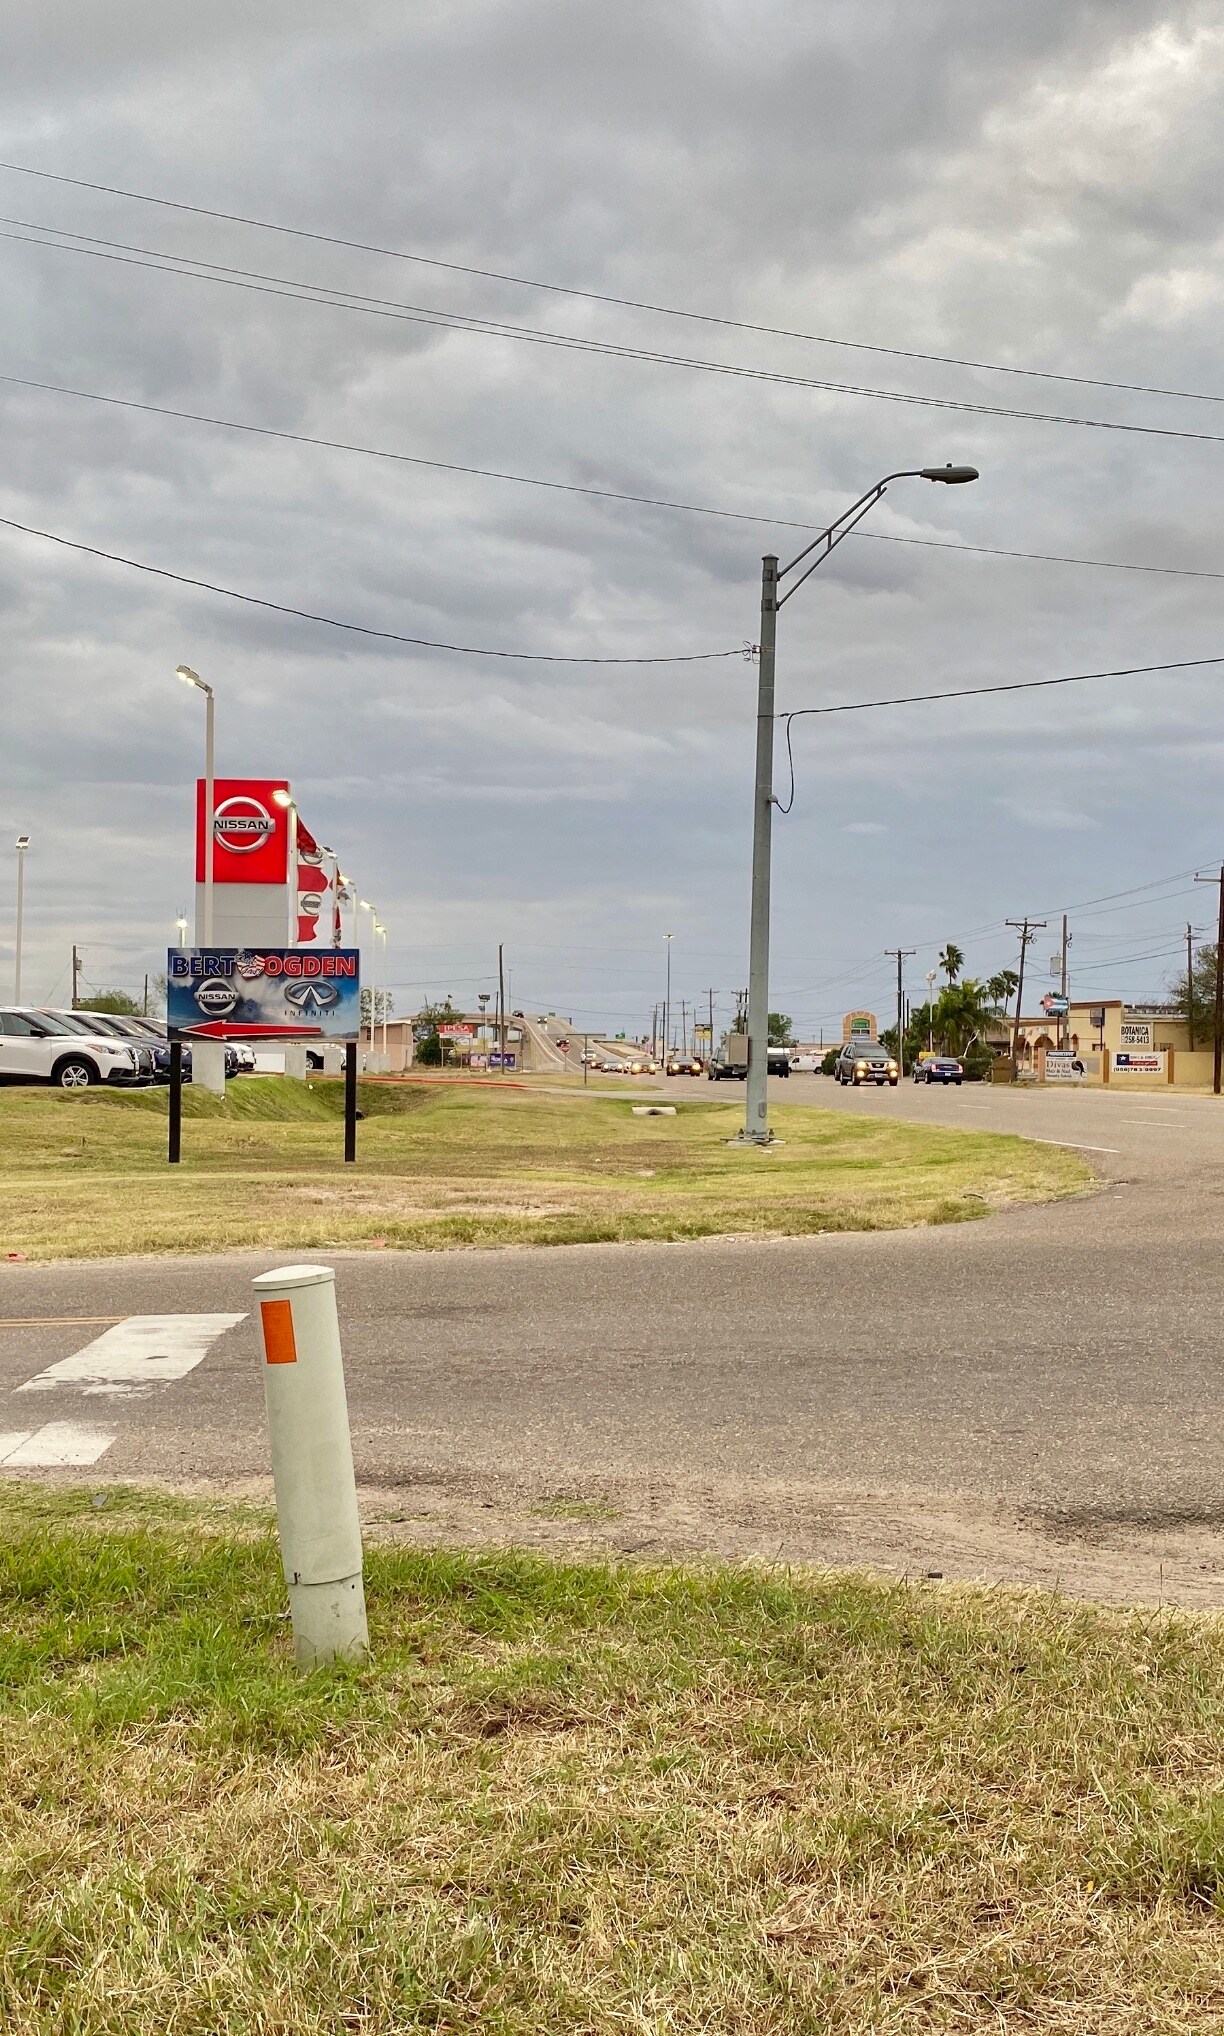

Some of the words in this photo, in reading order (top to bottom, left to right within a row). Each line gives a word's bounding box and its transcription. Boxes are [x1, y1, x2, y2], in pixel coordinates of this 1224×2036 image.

[213, 820, 269, 830] NISSAN
[171, 955, 236, 977] BERT
[264, 956, 356, 977] OGDEN
[284, 1009, 336, 1017] INFINITI
[1121, 1025, 1149, 1035] BOTANICA
[1046, 1060, 1071, 1068] Divas
